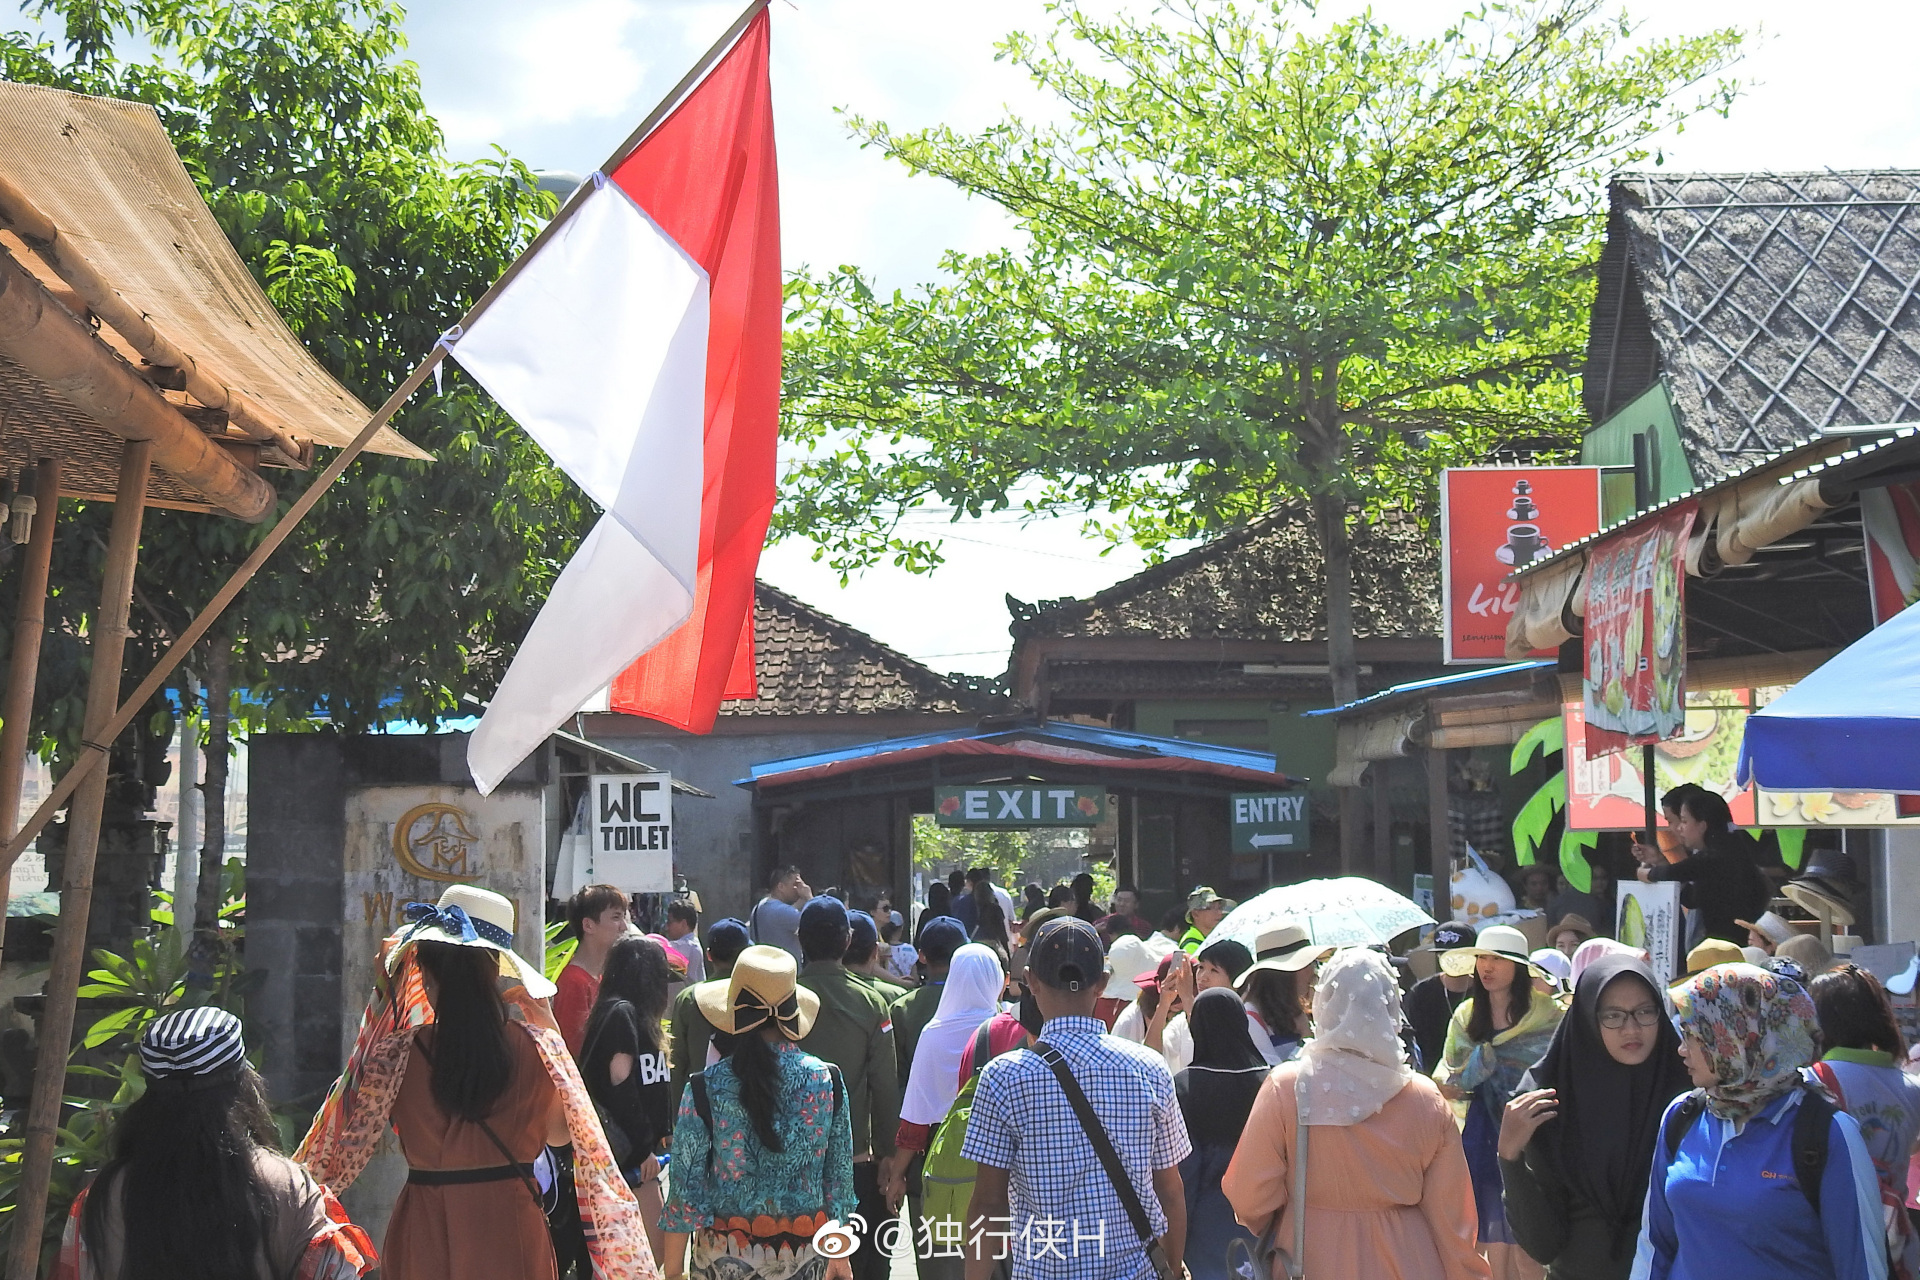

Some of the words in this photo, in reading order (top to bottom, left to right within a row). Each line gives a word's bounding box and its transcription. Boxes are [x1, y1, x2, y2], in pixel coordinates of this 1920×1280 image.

[600, 782, 660, 823] WC
[965, 790, 1075, 819] EXIT
[1235, 796, 1305, 824] ENTRY
[600, 826, 670, 851] TOILET
[639, 1050, 671, 1086] BA
